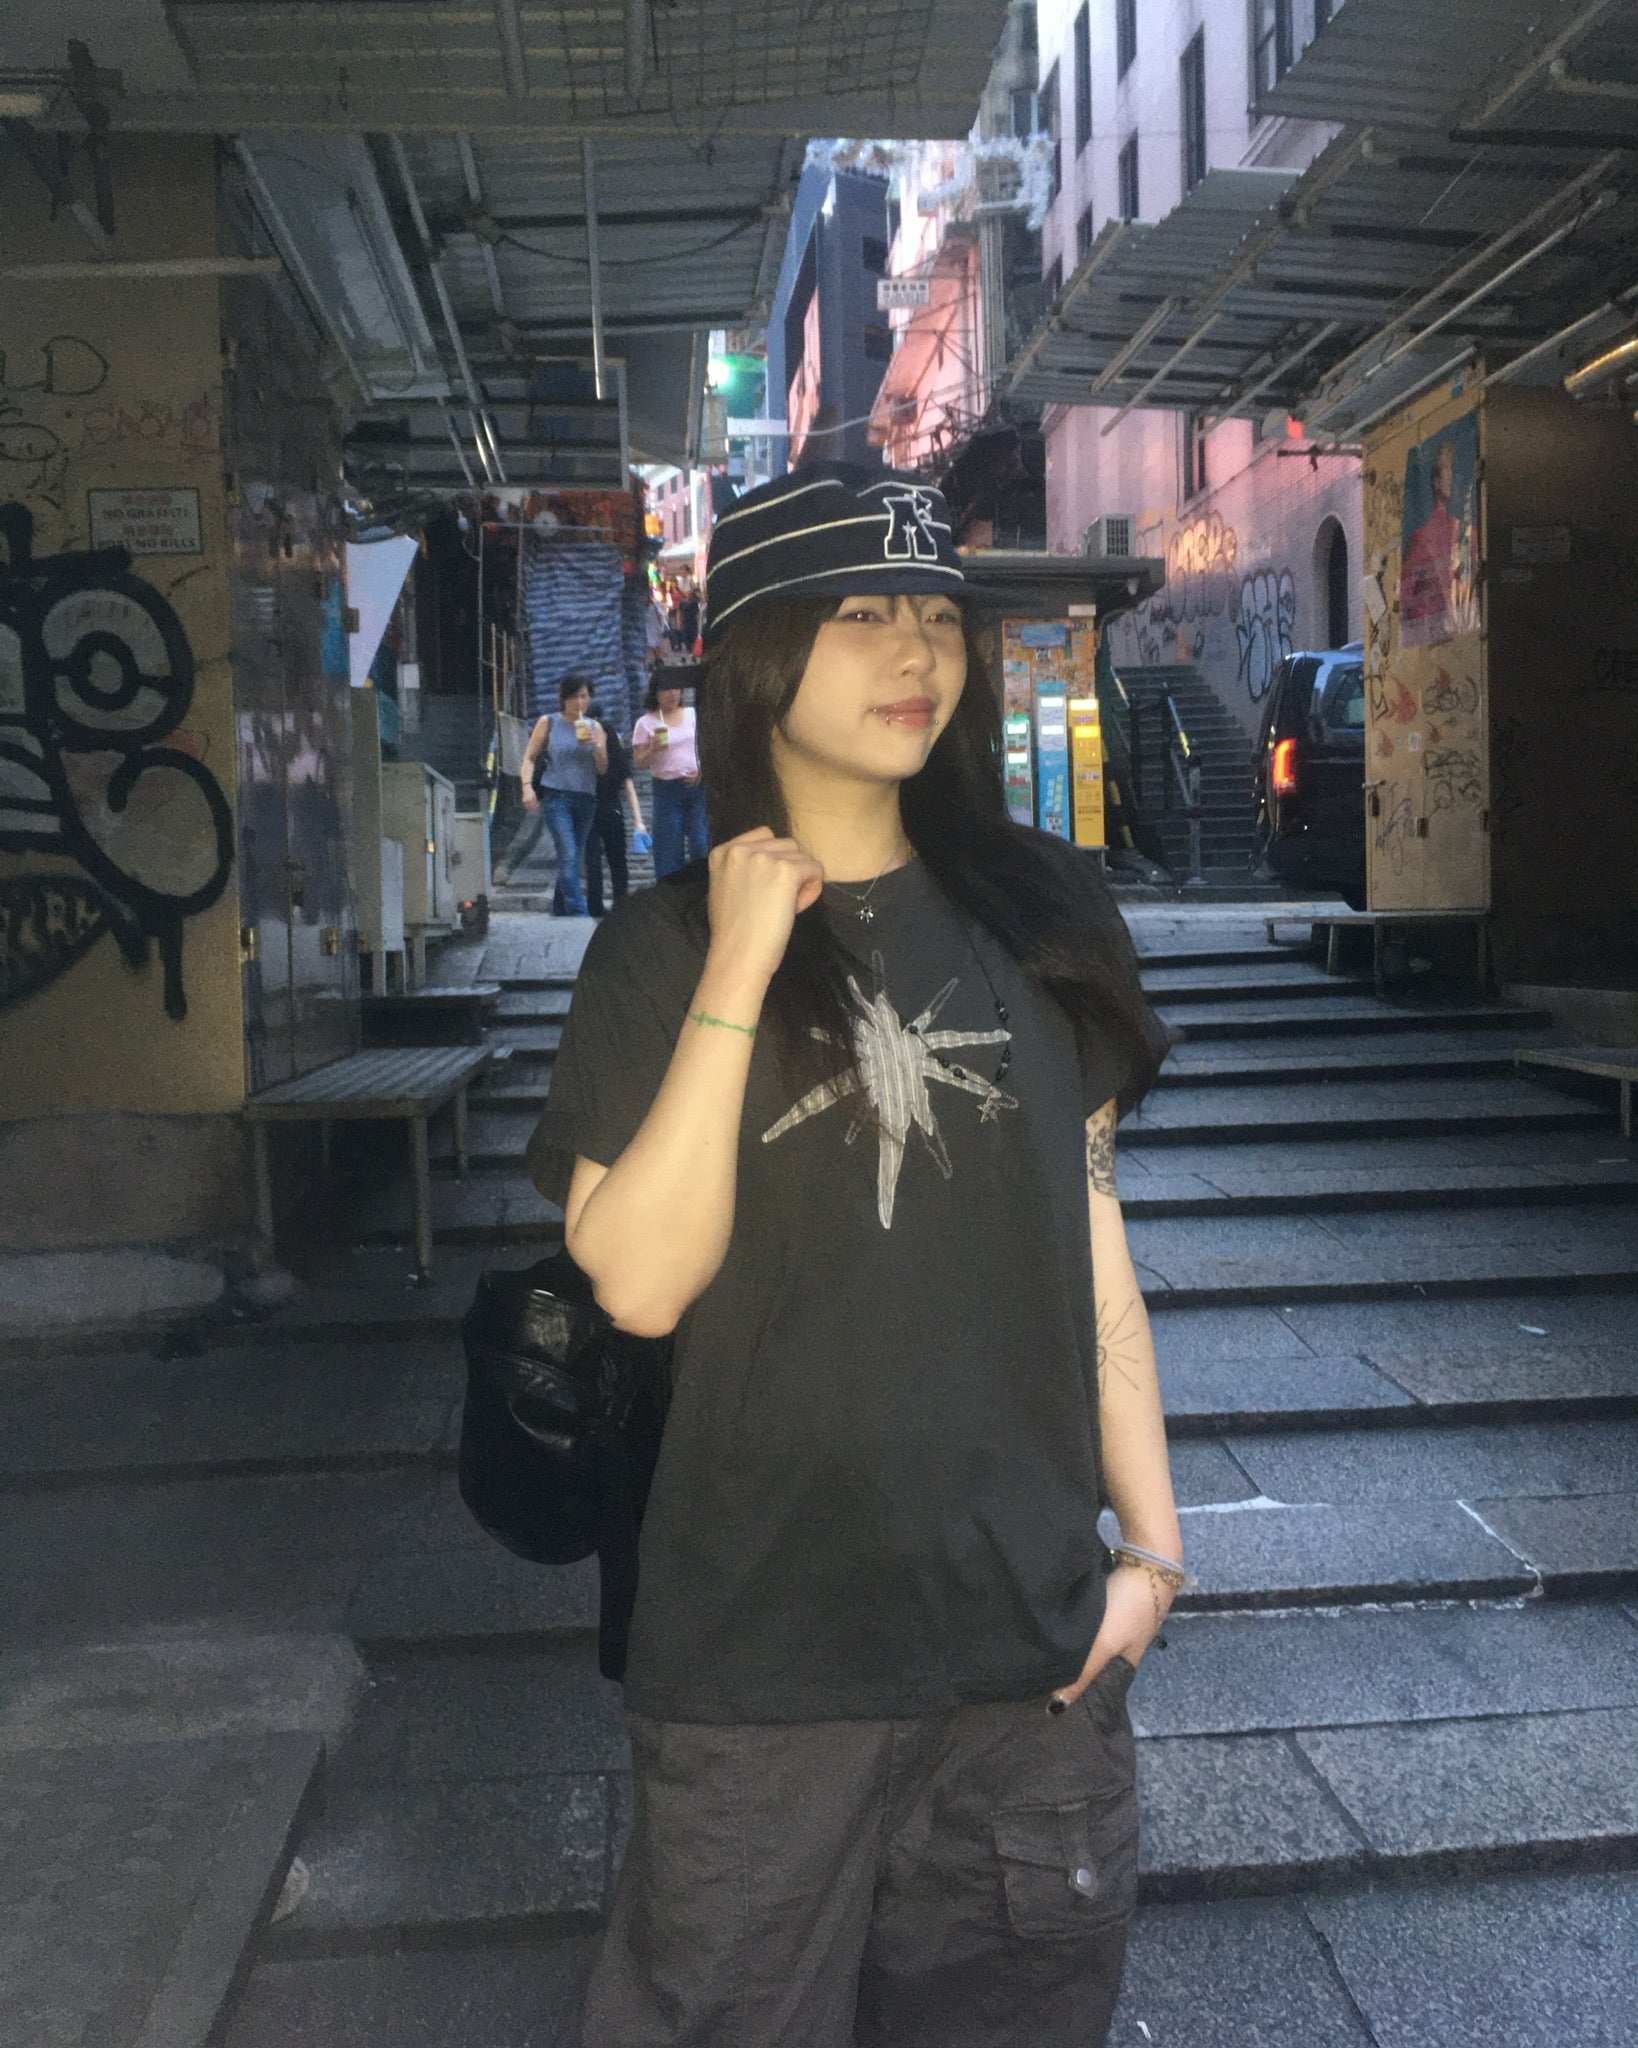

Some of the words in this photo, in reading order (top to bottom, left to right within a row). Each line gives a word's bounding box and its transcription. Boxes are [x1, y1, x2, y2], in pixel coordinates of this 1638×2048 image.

[102, 508, 124, 520] NO
[135, 538, 158, 549] NO
[160, 537, 196, 549] BILLS
